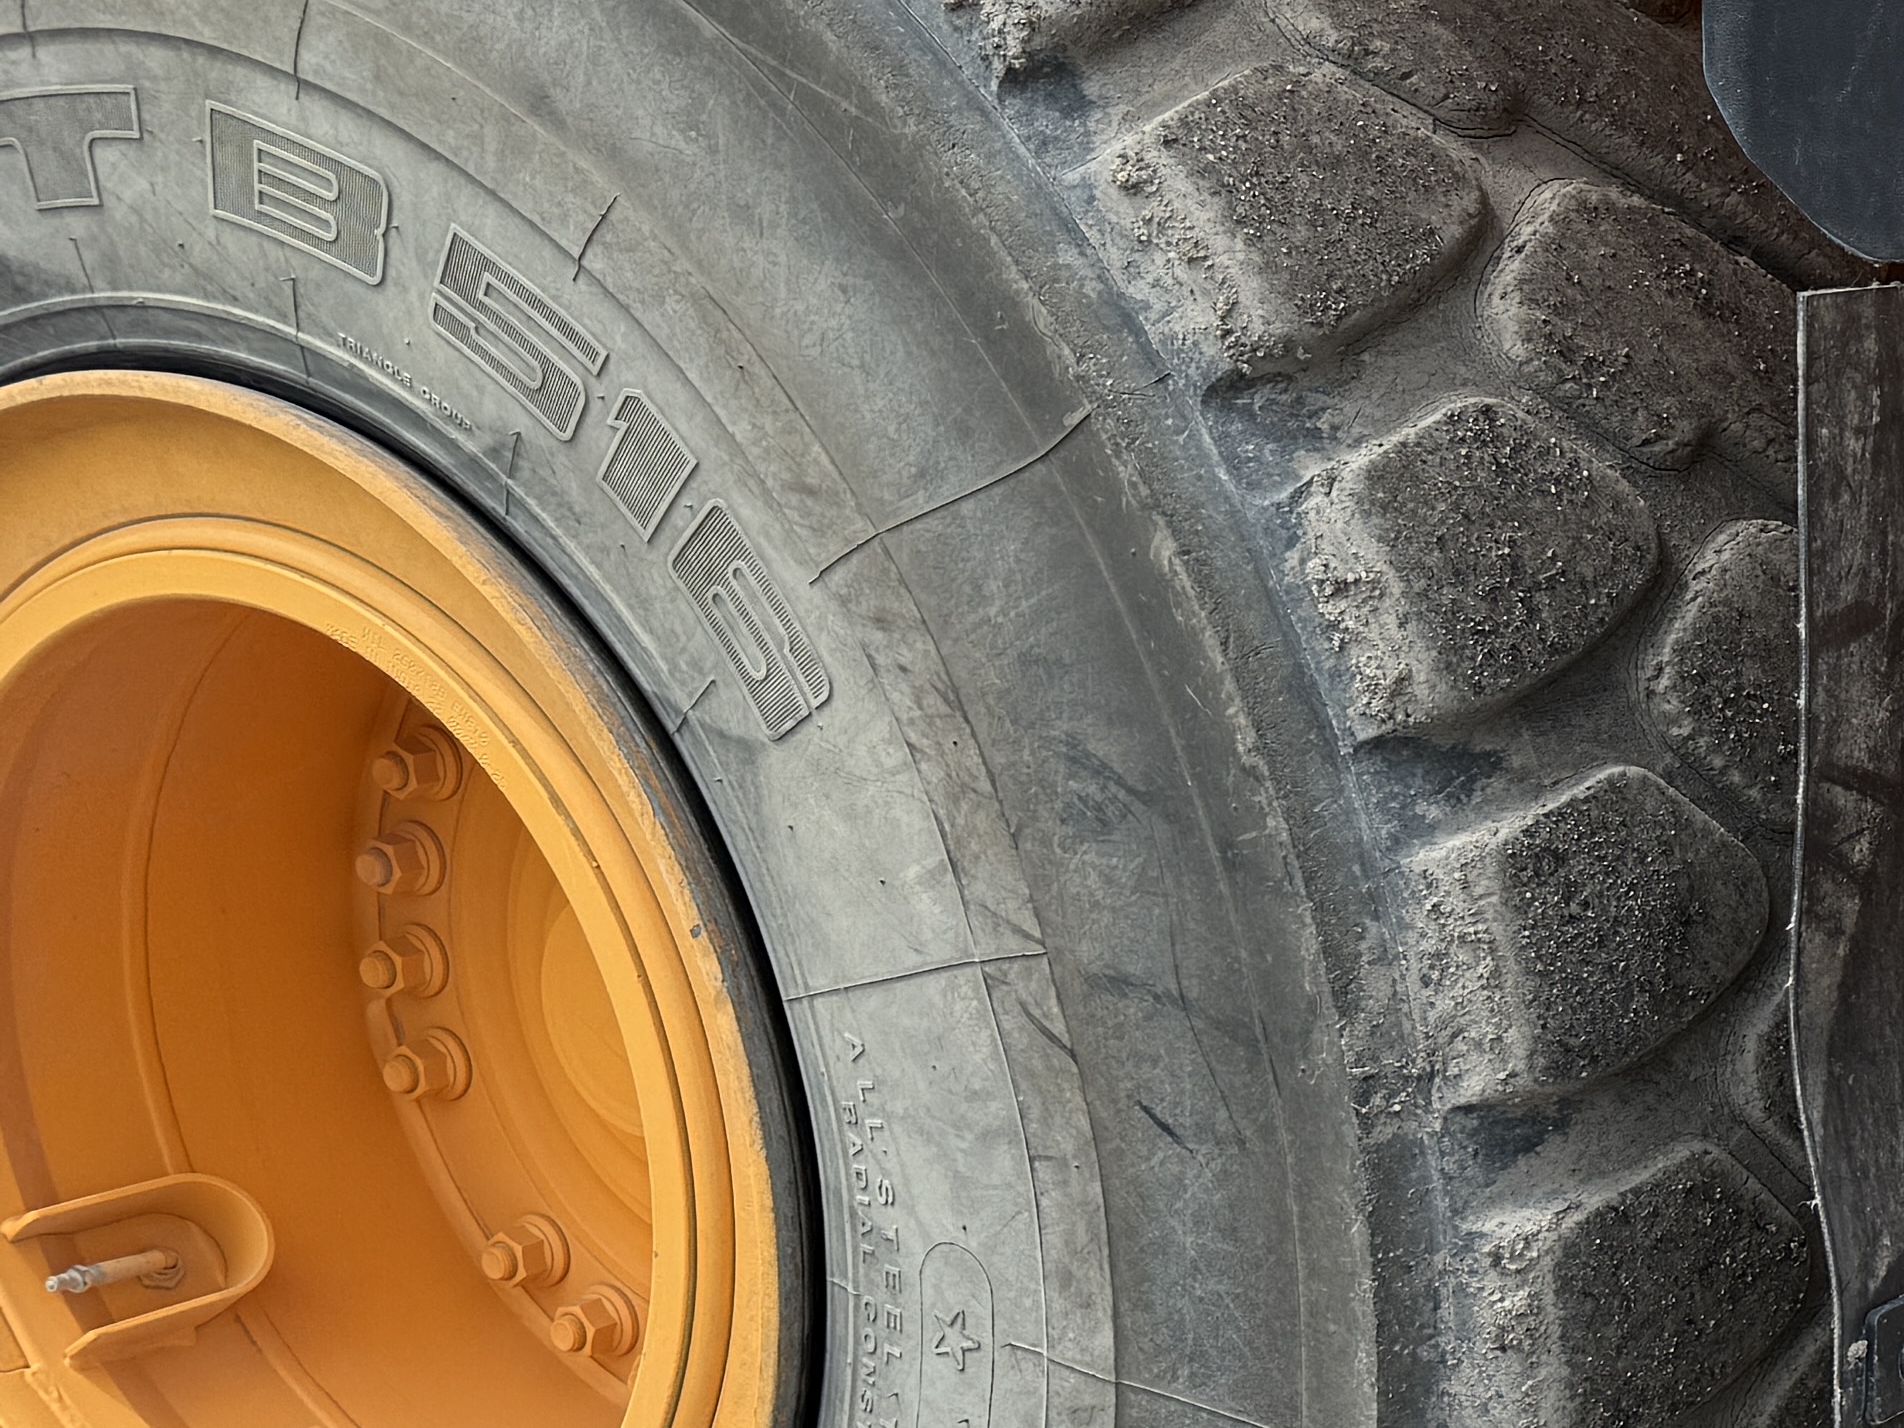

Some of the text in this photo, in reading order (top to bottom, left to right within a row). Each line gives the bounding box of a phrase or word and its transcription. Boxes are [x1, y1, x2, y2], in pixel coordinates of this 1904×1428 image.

[338, 332, 473, 432] TRIANGLE GROUP
[841, 1101, 875, 1264] RADIAL
[876, 1175, 903, 1364] STEEL
